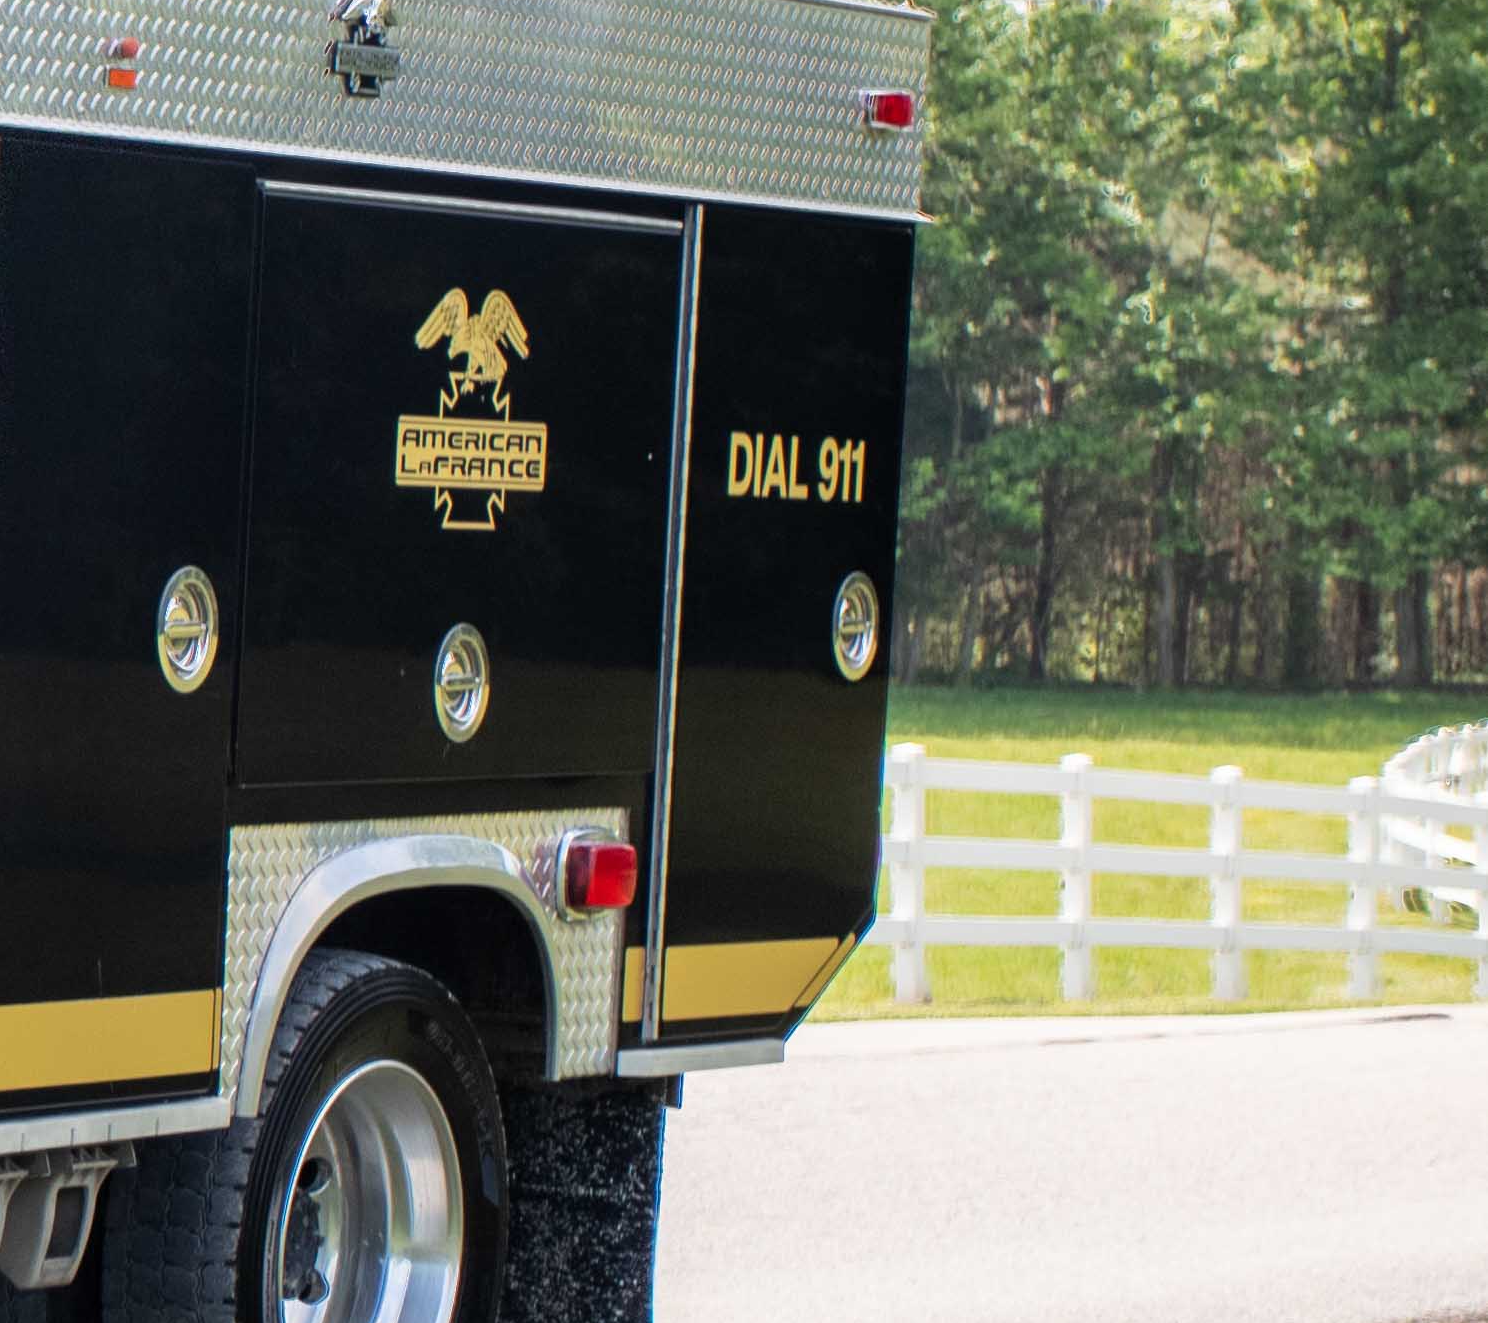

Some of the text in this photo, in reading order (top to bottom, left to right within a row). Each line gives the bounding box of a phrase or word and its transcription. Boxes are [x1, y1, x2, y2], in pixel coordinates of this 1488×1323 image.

[401, 429, 542, 454] AMERICAN
[728, 431, 866, 502] DIAL 911
